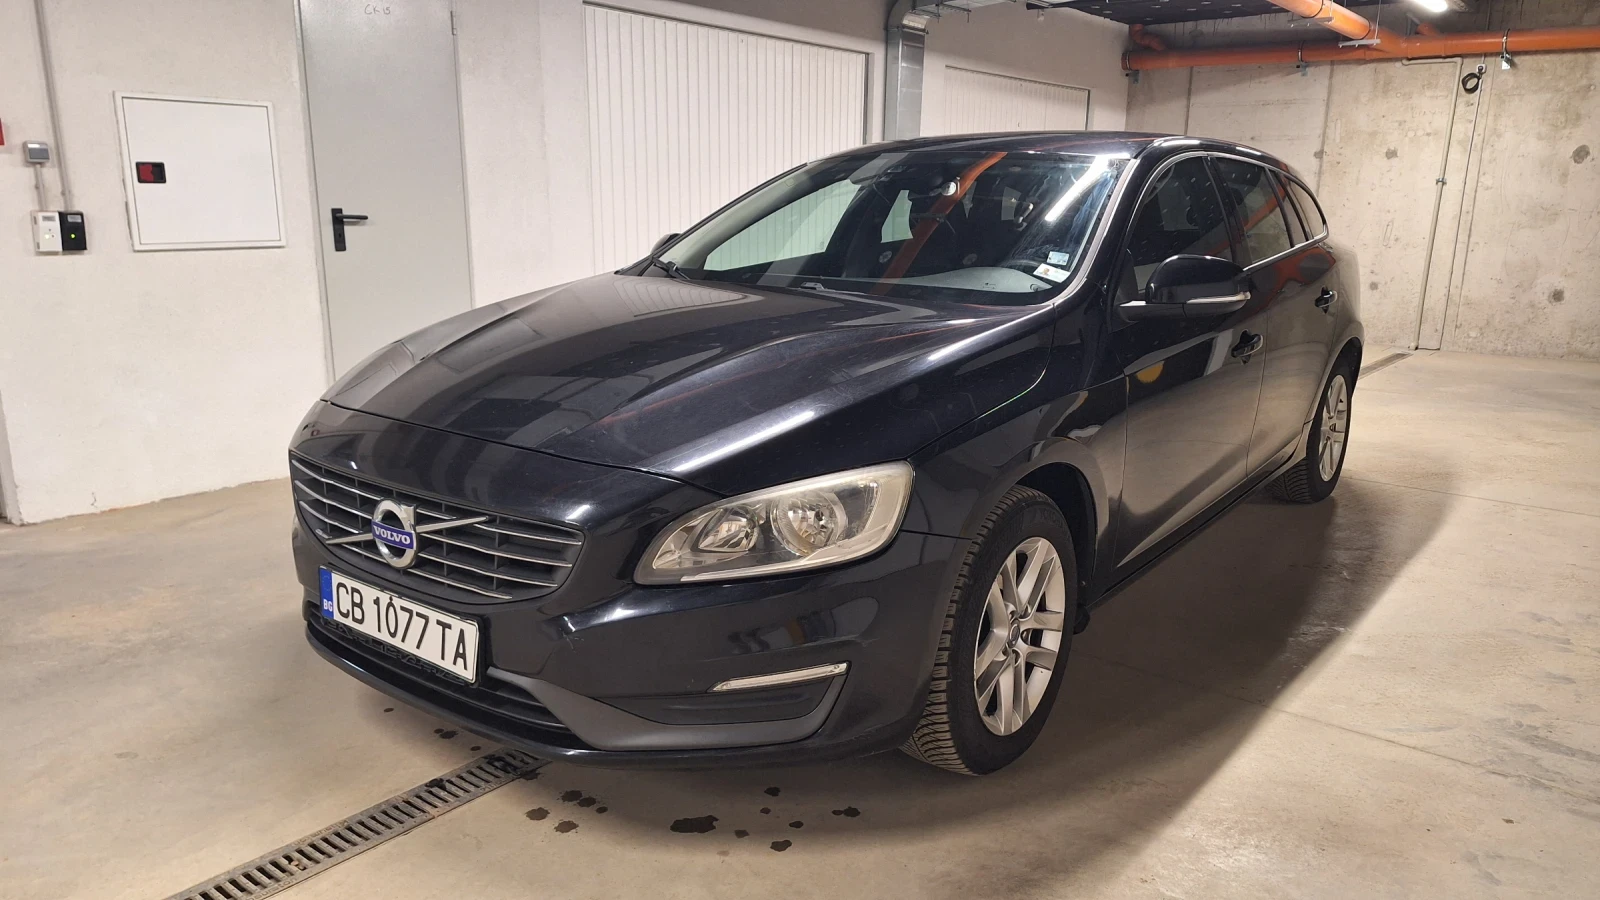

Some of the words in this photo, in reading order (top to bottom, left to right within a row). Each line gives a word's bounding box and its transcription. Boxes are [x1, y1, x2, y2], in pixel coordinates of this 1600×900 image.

[373, 525, 411, 545] VOLVO
[323, 598, 333, 612] BG
[336, 582, 365, 625] CB
[373, 596, 430, 649] 1077
[436, 619, 468, 671] TA
